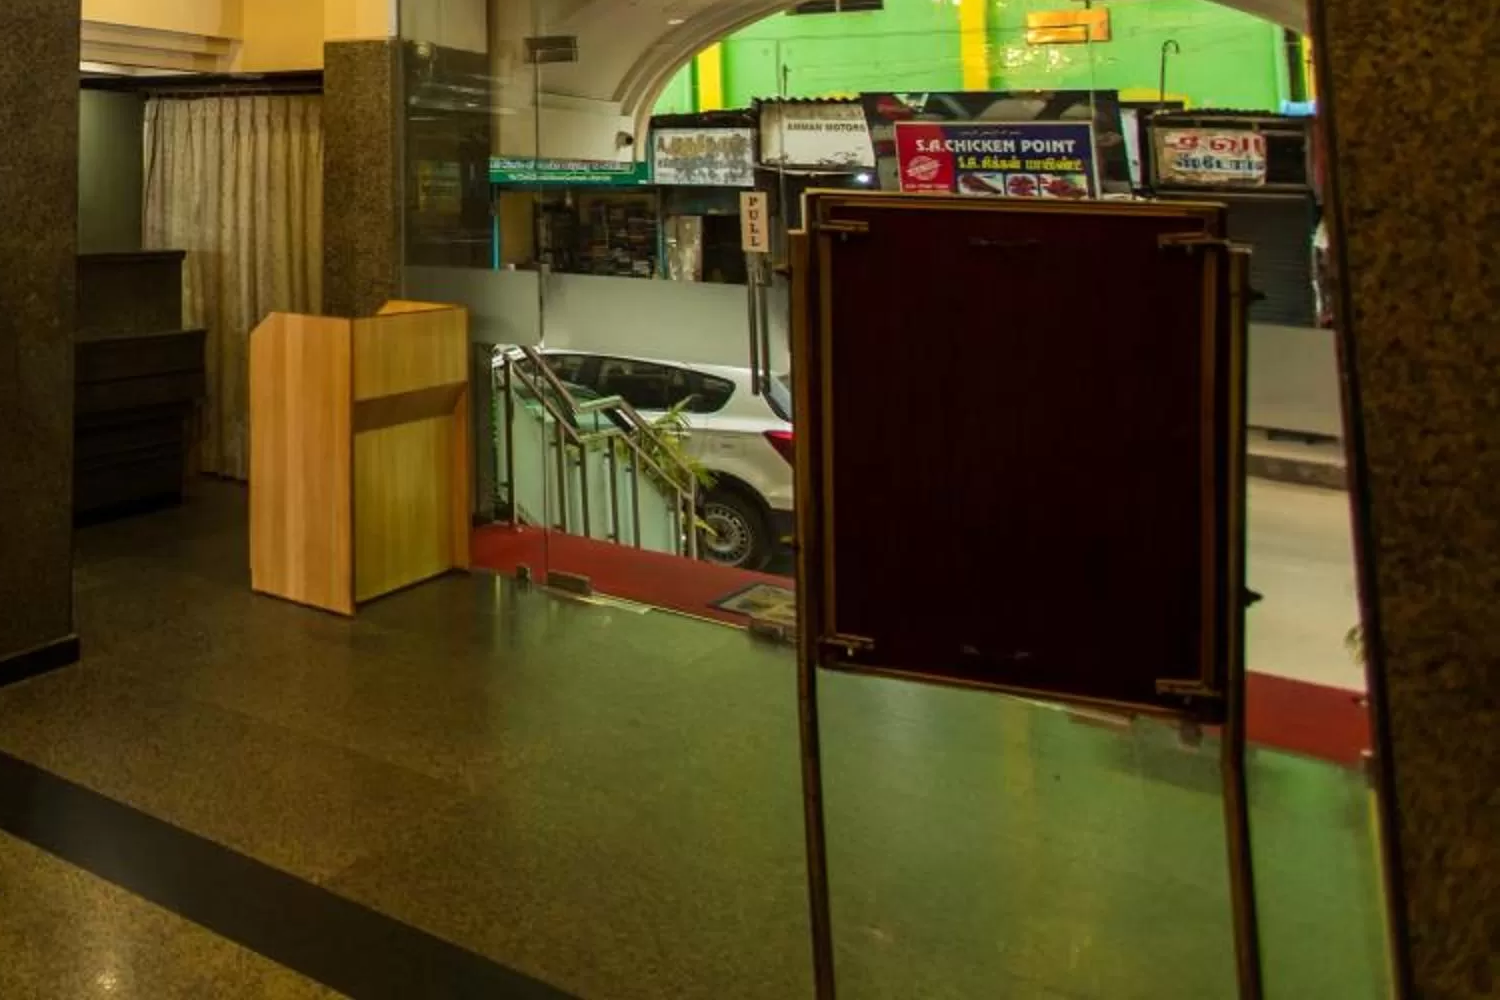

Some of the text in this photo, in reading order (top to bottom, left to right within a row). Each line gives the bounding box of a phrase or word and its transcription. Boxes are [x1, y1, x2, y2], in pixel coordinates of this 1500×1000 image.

[788, 123, 866, 132] AMMAN MOTORS
[1021, 139, 1076, 153] POINT
[748, 196, 760, 247] PULL
